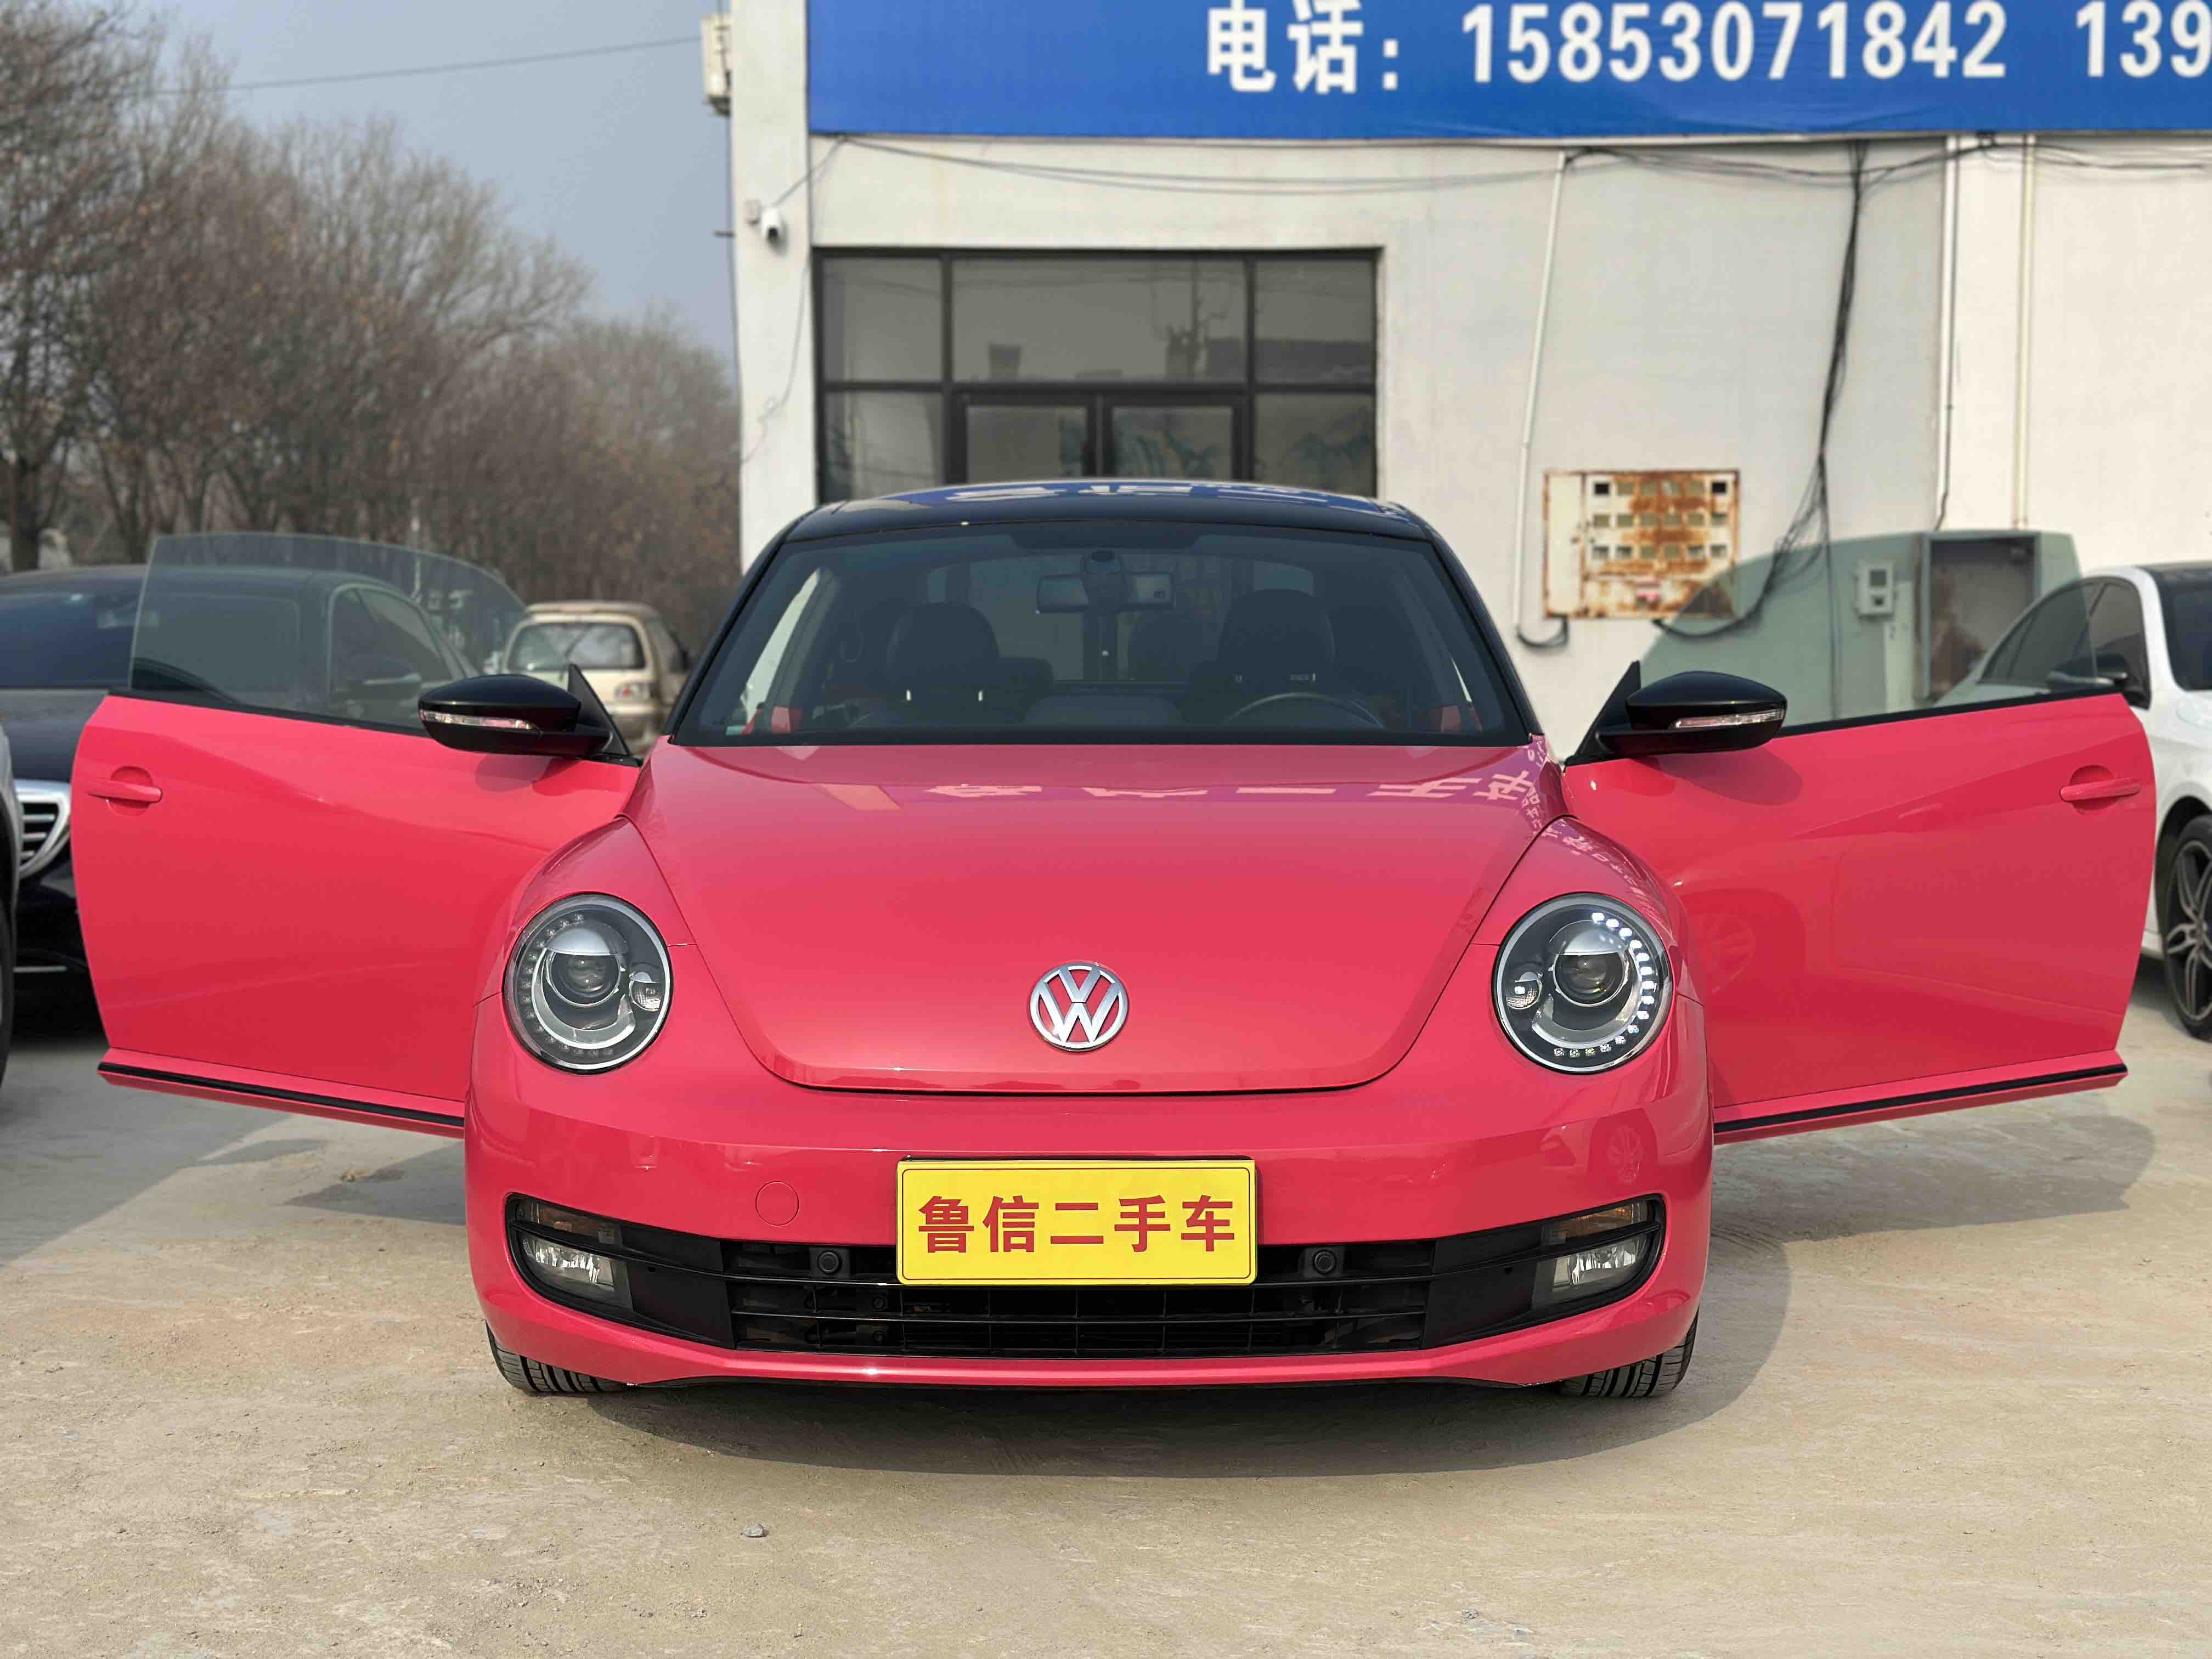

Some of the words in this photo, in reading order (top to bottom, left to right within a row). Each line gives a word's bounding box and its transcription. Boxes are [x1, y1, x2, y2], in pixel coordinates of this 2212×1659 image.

[1463, 0, 2006, 82] 15853071842
[2076, 0, 2212, 77] 139
[918, 1194, 1235, 1253] 鲁信二手车
